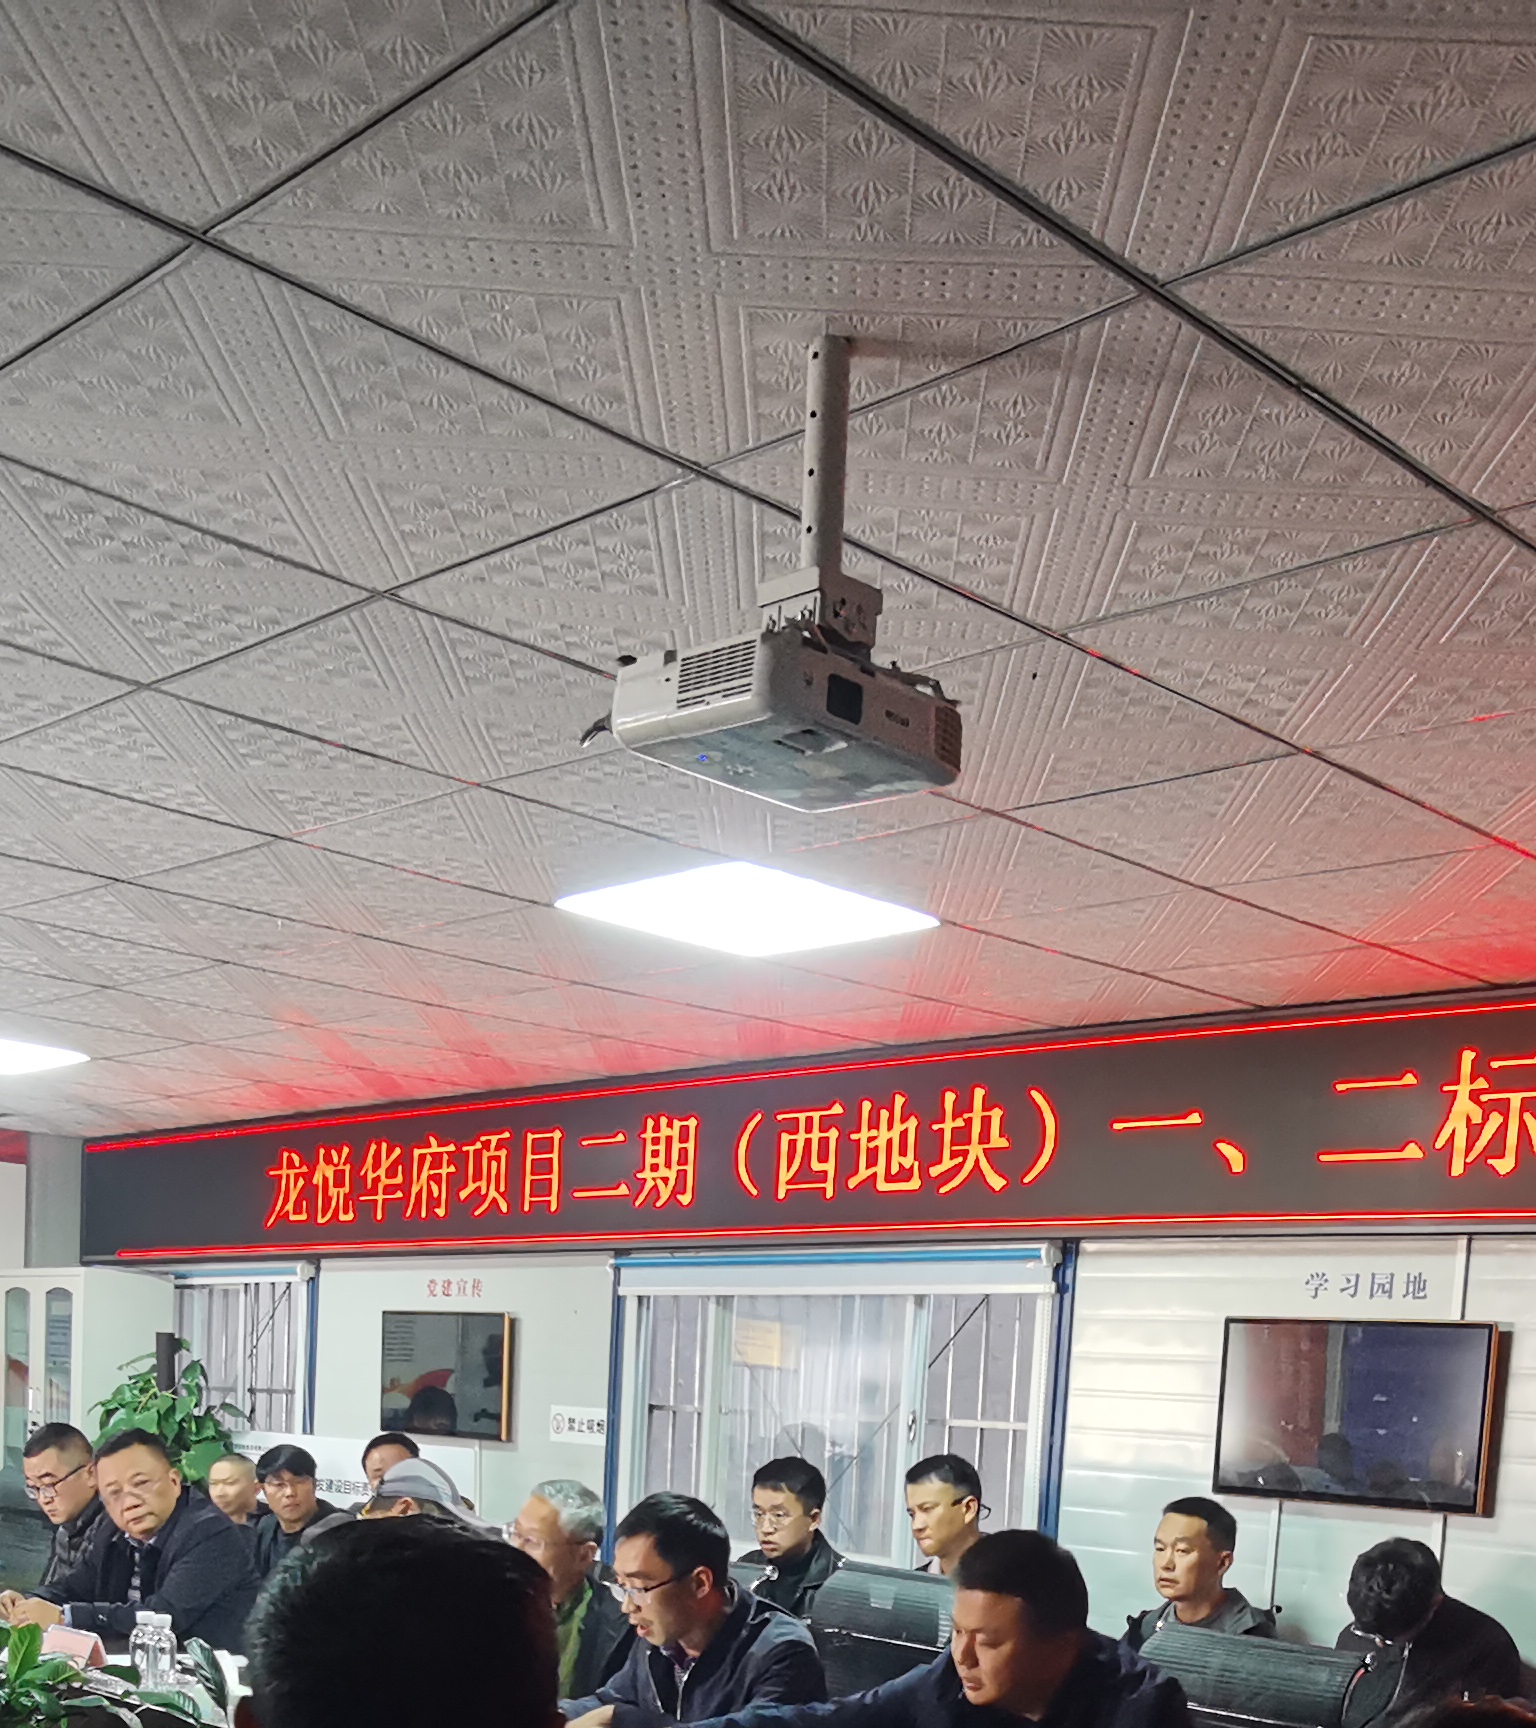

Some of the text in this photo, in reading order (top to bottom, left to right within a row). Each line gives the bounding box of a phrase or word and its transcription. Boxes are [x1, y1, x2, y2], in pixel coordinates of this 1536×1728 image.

[427, 1278, 484, 1298] 党建宣传
[1304, 1271, 1428, 1300] 学习园地
